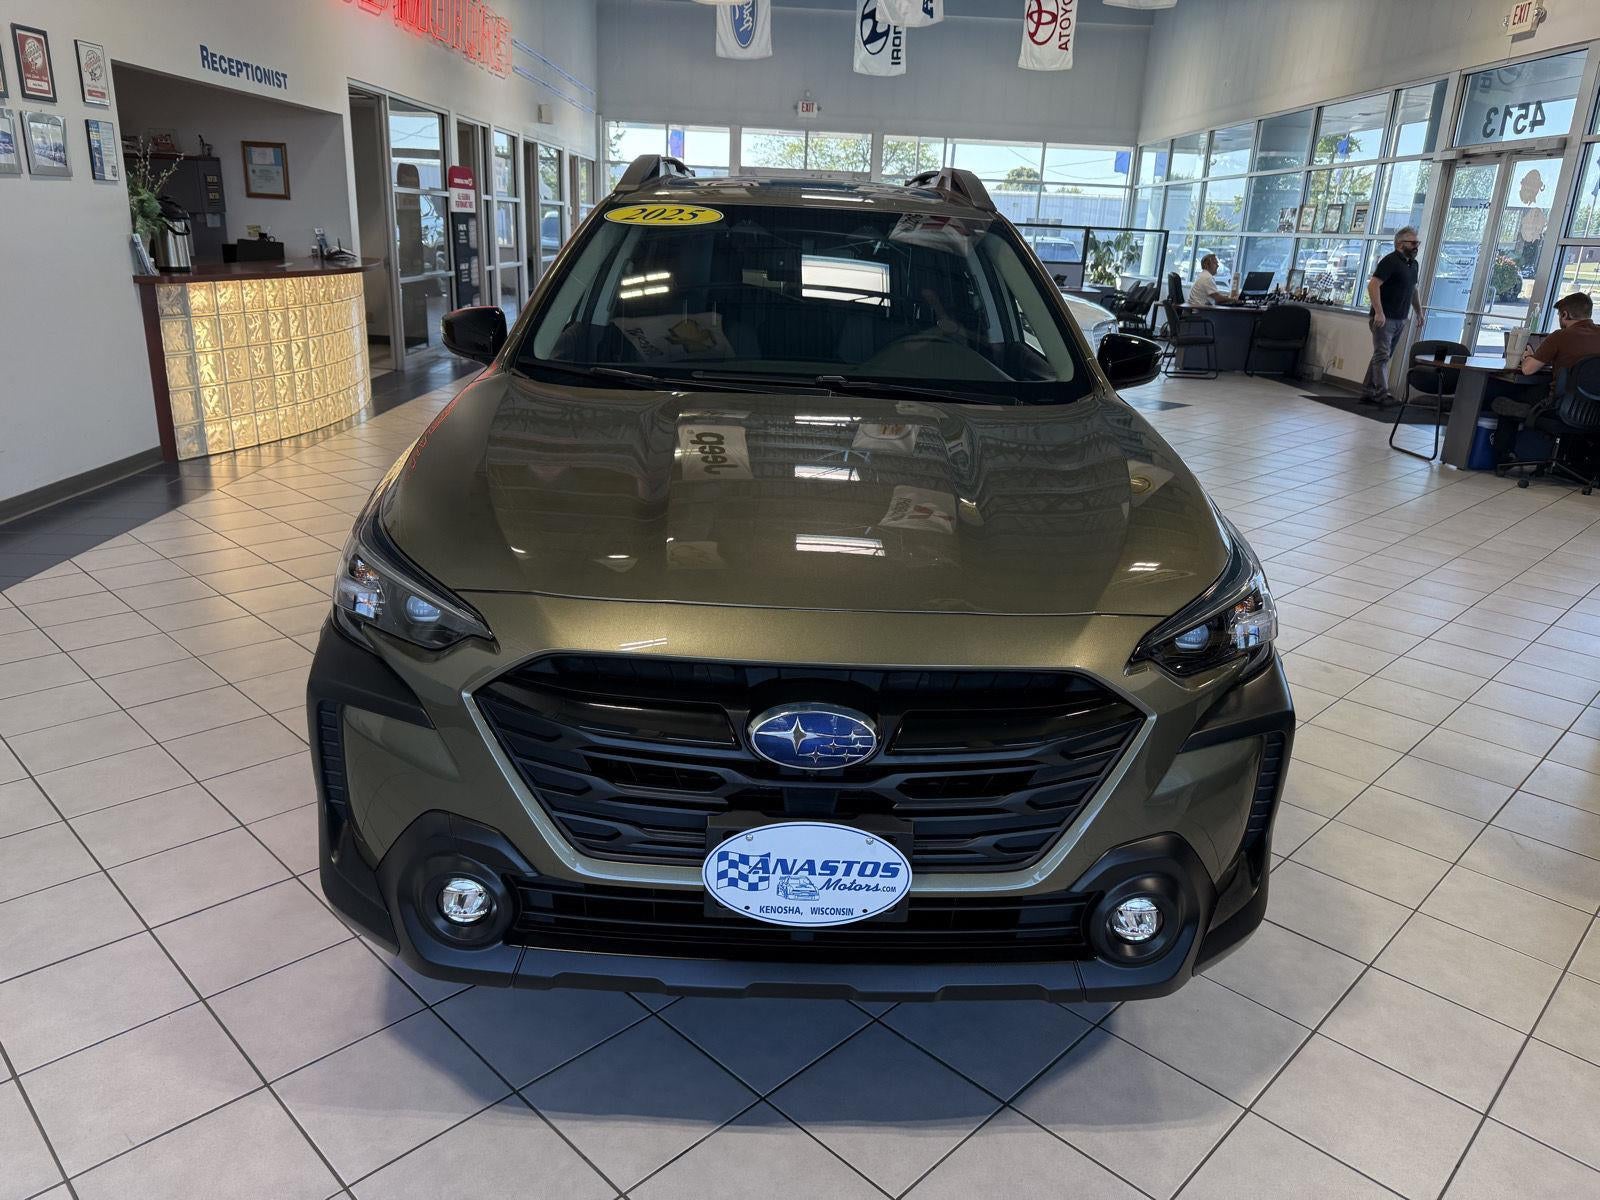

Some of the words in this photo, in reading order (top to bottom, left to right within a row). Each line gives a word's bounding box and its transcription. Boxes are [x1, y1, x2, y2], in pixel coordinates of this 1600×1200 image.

[1512, 2, 1532, 25] EXIT
[199, 44, 288, 90] RECEPTIONIST
[801, 102, 815, 112] EXIT
[621, 208, 706, 221] 2025
[747, 857, 901, 878] ANASTOS
[759, 905, 803, 916] KENOSHA,
[810, 907, 854, 916] WISCONSIN
